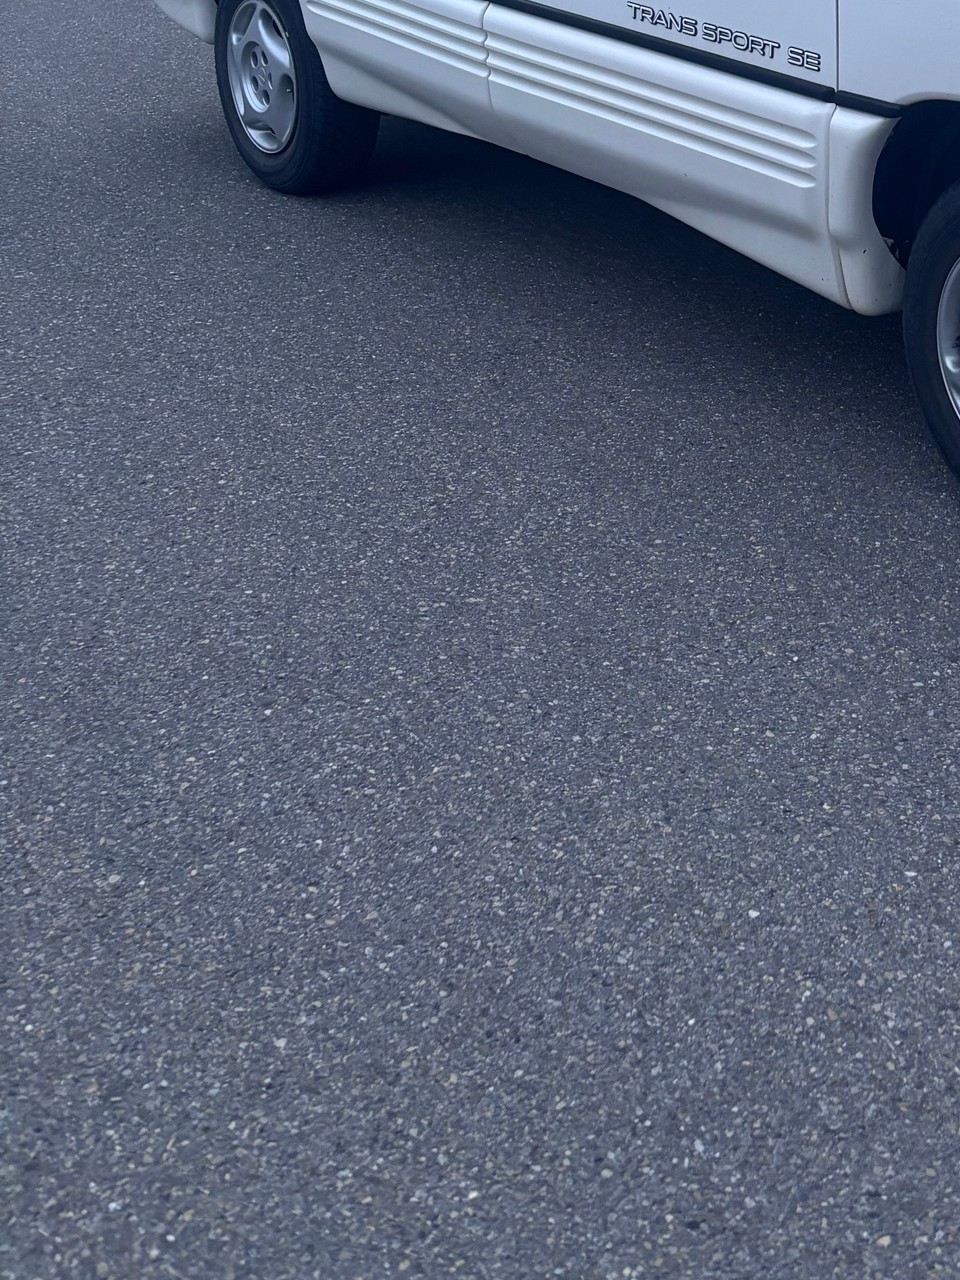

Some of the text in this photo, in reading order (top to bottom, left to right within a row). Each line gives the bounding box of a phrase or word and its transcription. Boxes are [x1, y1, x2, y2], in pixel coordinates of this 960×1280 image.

[627, 1, 821, 71] TRANS SPORT SE
